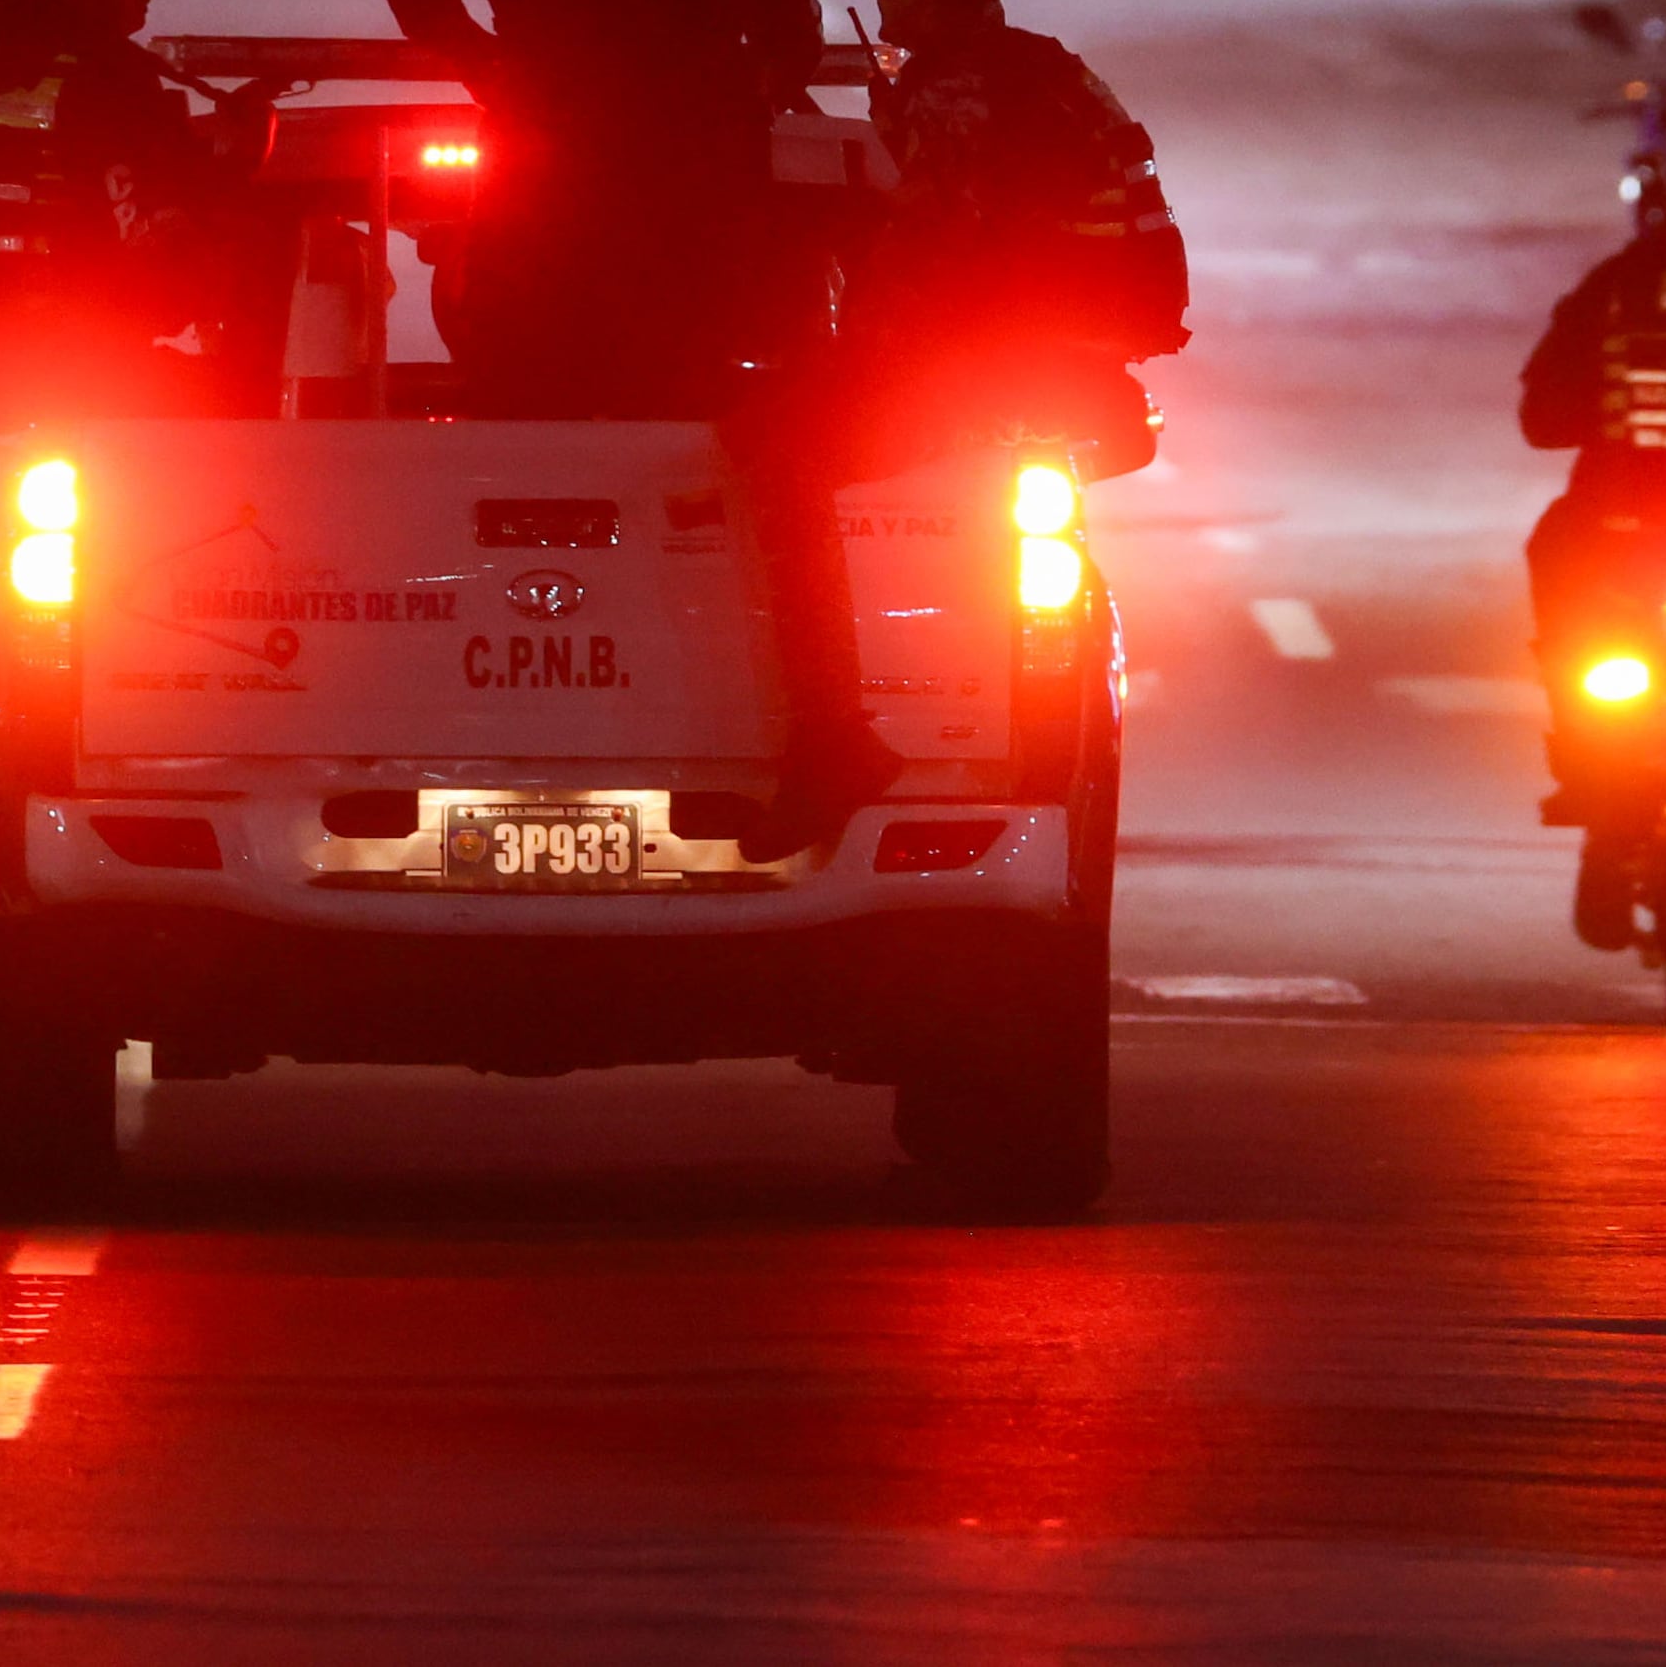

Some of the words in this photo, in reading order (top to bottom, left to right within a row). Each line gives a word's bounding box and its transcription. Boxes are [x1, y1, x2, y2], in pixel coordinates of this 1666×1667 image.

[905, 517, 958, 536] PAZ
[171, 590, 357, 621] CUADRANTES
[365, 591, 398, 621] DE
[405, 591, 457, 621] PAZ
[464, 635, 630, 688] C.P.N.B.
[494, 823, 631, 875] 3P933
